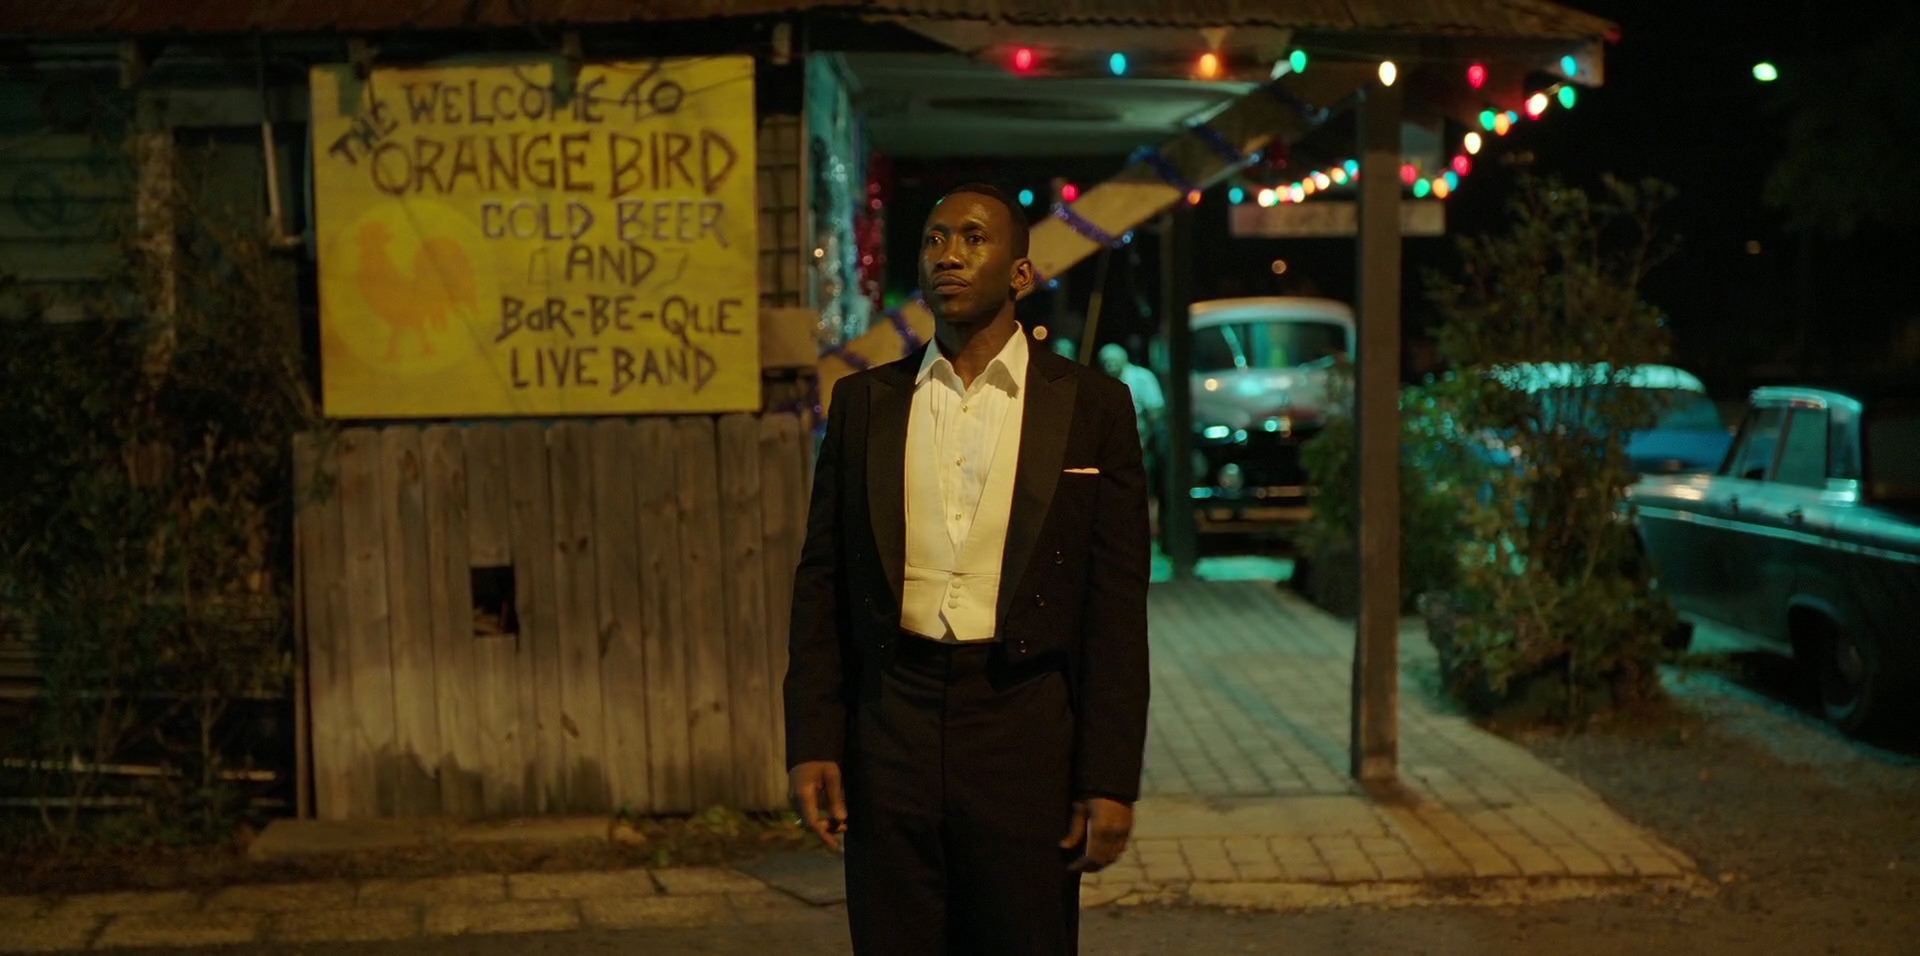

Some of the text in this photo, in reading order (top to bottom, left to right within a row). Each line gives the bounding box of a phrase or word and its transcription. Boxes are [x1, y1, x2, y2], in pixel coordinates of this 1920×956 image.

[329, 100, 398, 165] THE
[371, 130, 738, 198] ORANGE BIRD
[481, 201, 728, 248] COLD BEER
[565, 245, 655, 286] AND
[511, 346, 716, 394] LIVE BAND
